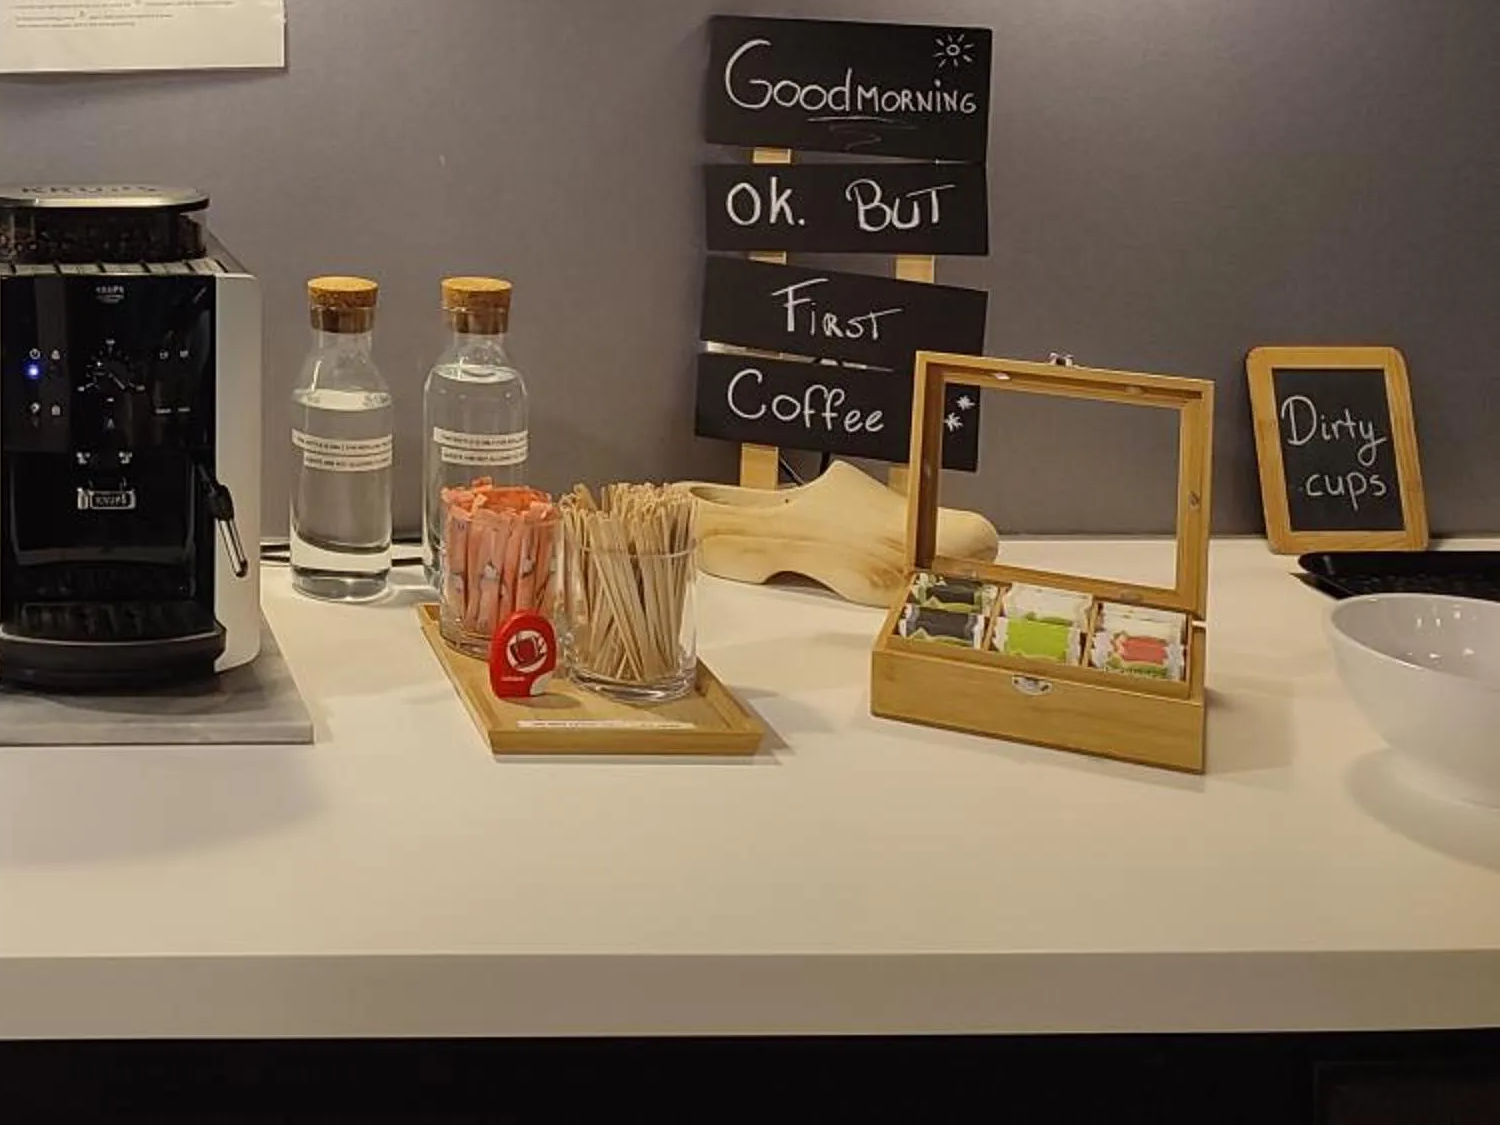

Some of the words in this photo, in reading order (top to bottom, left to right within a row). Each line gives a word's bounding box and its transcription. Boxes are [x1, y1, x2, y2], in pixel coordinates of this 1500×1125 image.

[728, 369, 883, 432] Coffee
[1278, 395, 1386, 469] Dirty
[1306, 472, 1386, 510] cups
